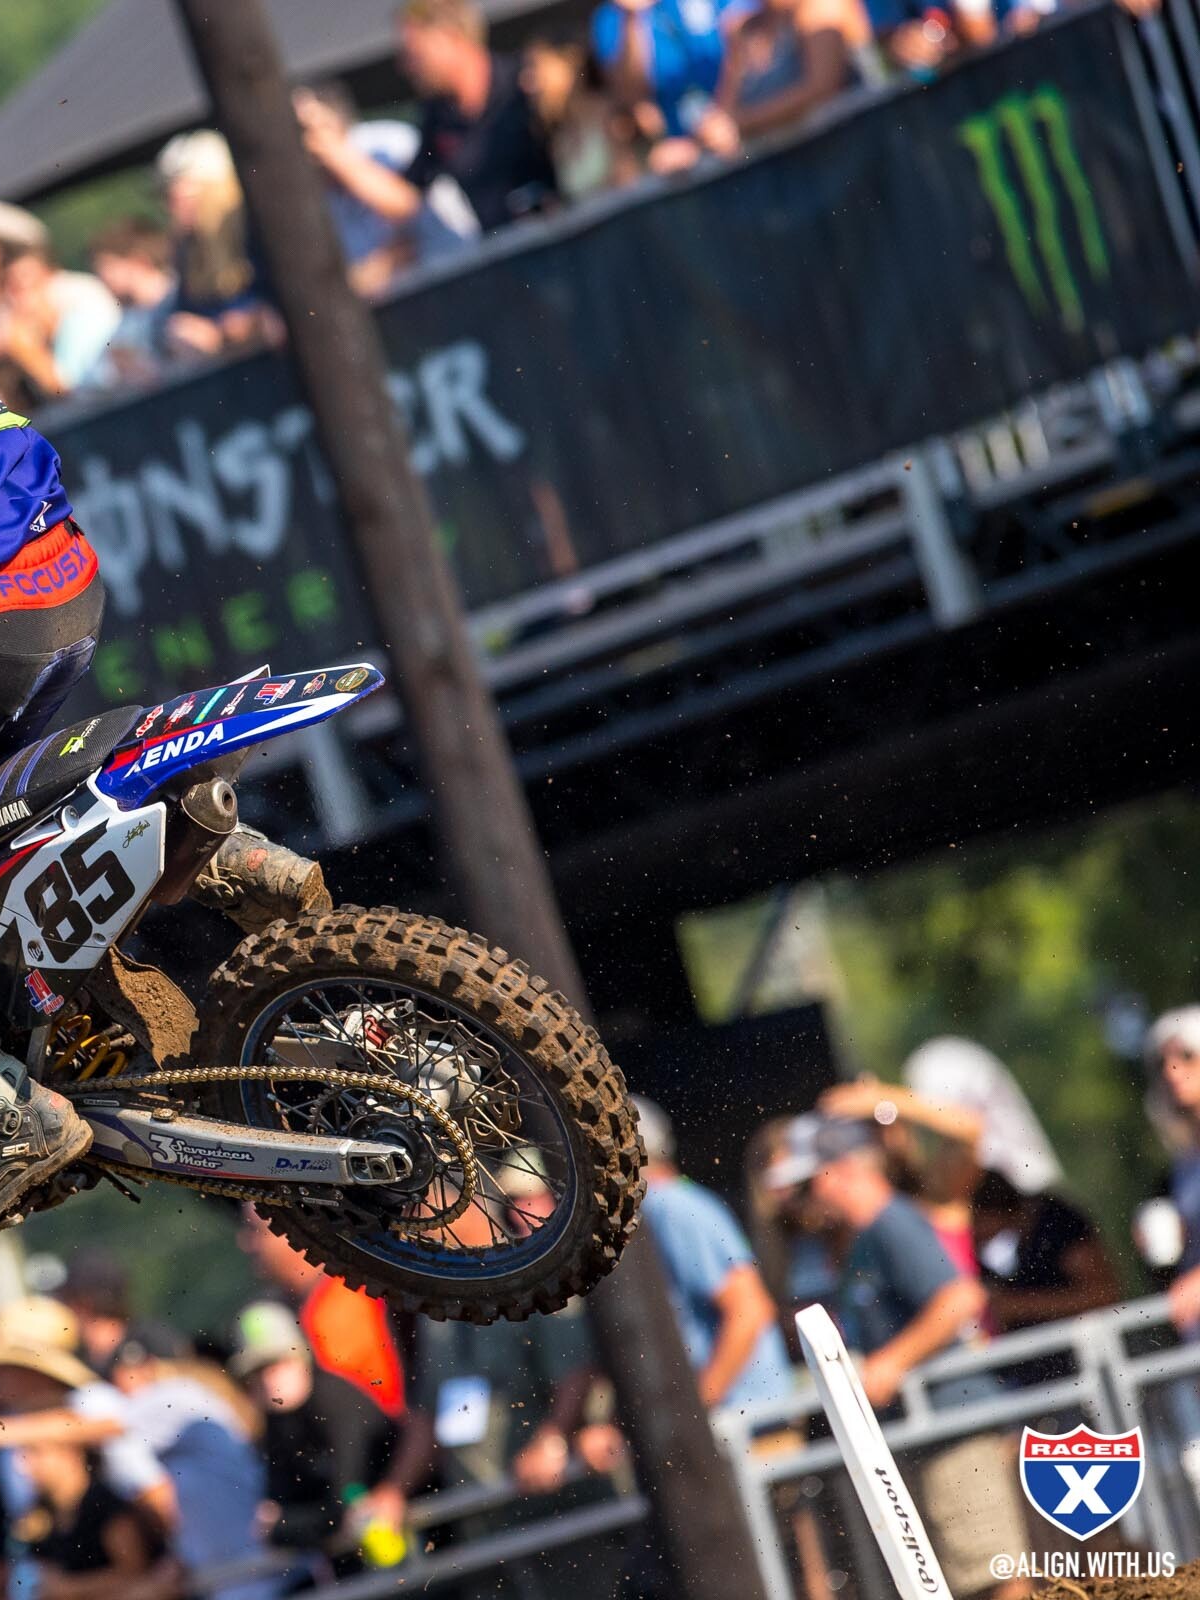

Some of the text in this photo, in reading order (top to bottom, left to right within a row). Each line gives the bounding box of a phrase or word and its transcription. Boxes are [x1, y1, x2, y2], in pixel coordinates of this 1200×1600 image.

[23, 818, 136, 963] 85
[150, 1133, 253, 1164] 3 Seventeen
[177, 1152, 221, 1168] Moto
